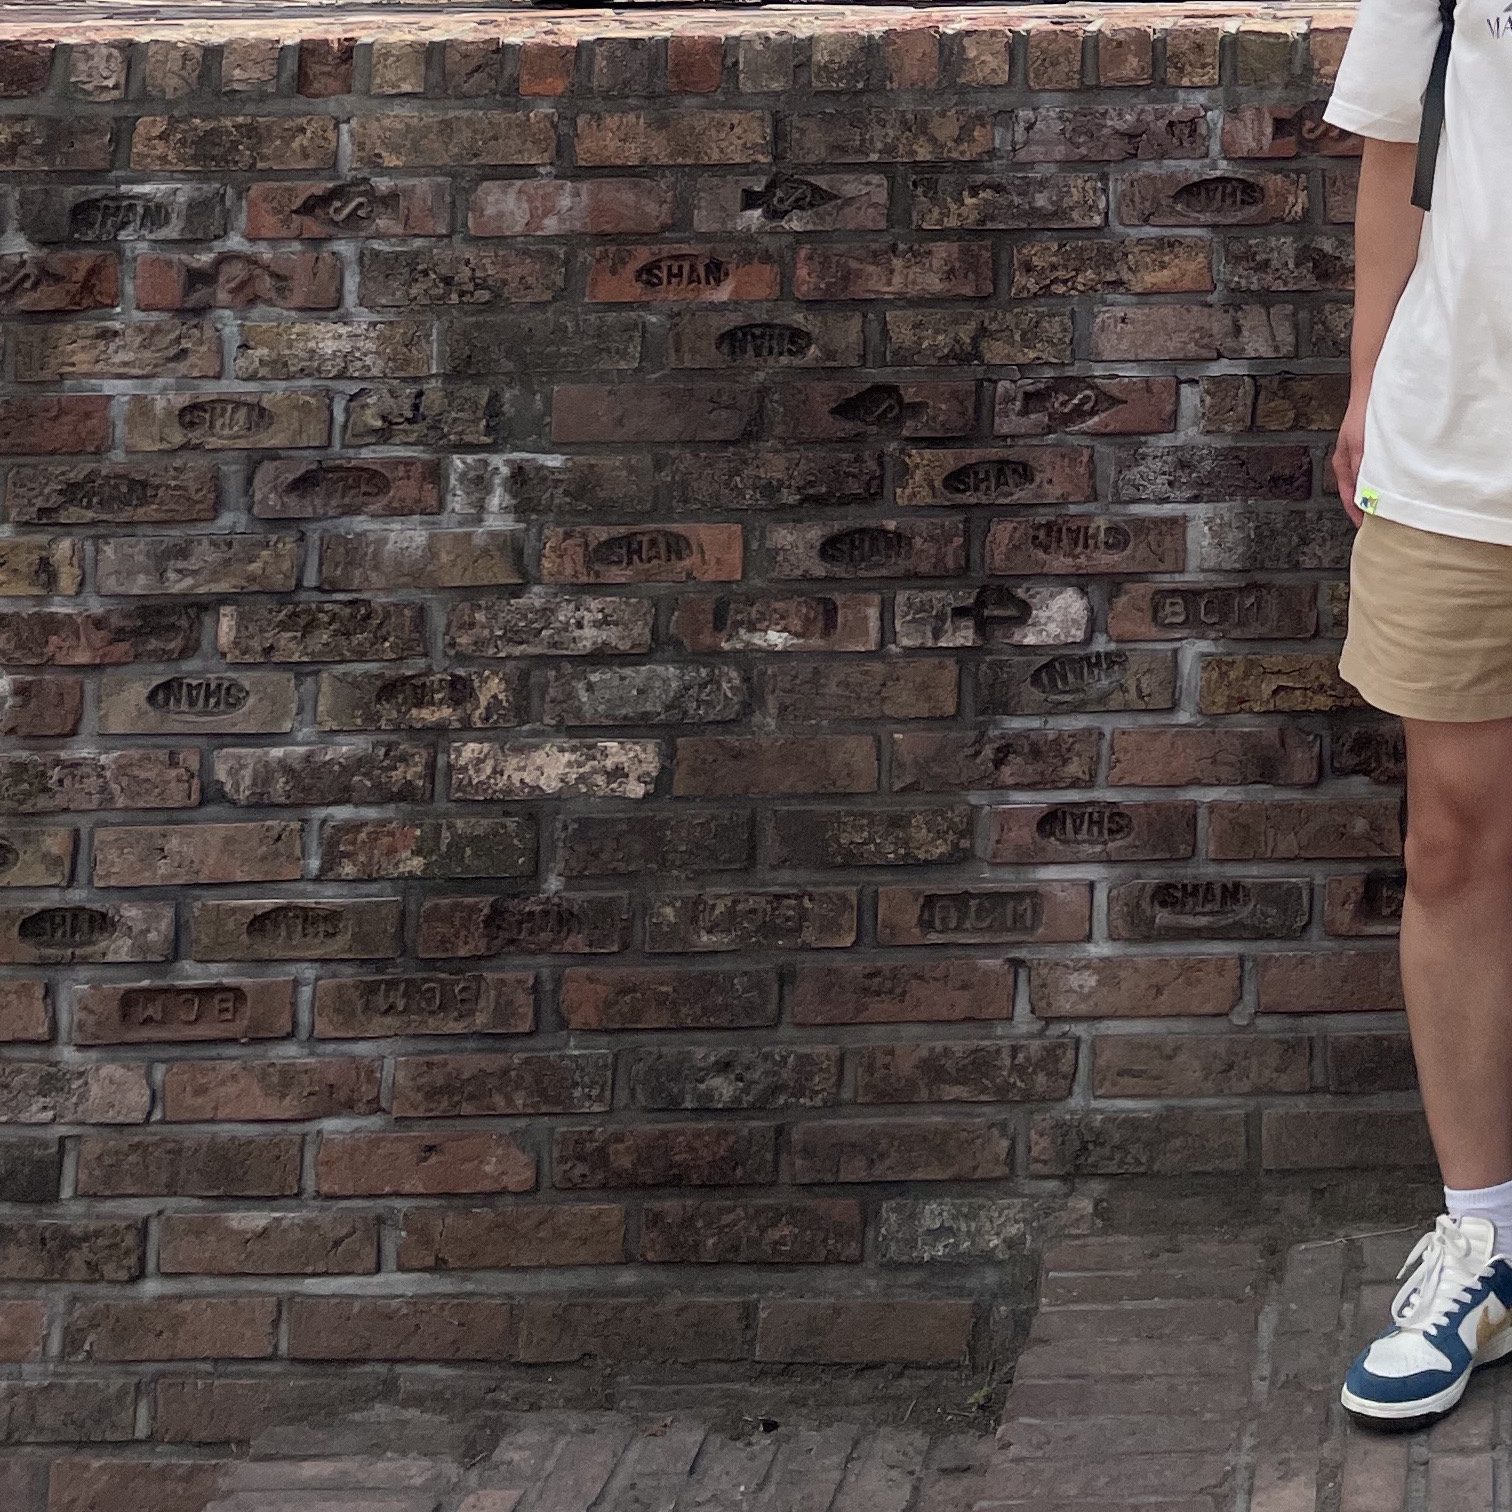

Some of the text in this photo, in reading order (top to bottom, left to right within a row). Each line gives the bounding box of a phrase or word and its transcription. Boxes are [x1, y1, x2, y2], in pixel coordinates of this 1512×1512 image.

[650, 263, 725, 288] SHAN
[955, 461, 1034, 494] SHAN
[607, 537, 689, 566] SHAN
[153, 677, 247, 710] SHAN
[1053, 807, 1132, 839] SHAN
[1156, 881, 1252, 913] SHAN
[137, 991, 236, 1025] BCM
